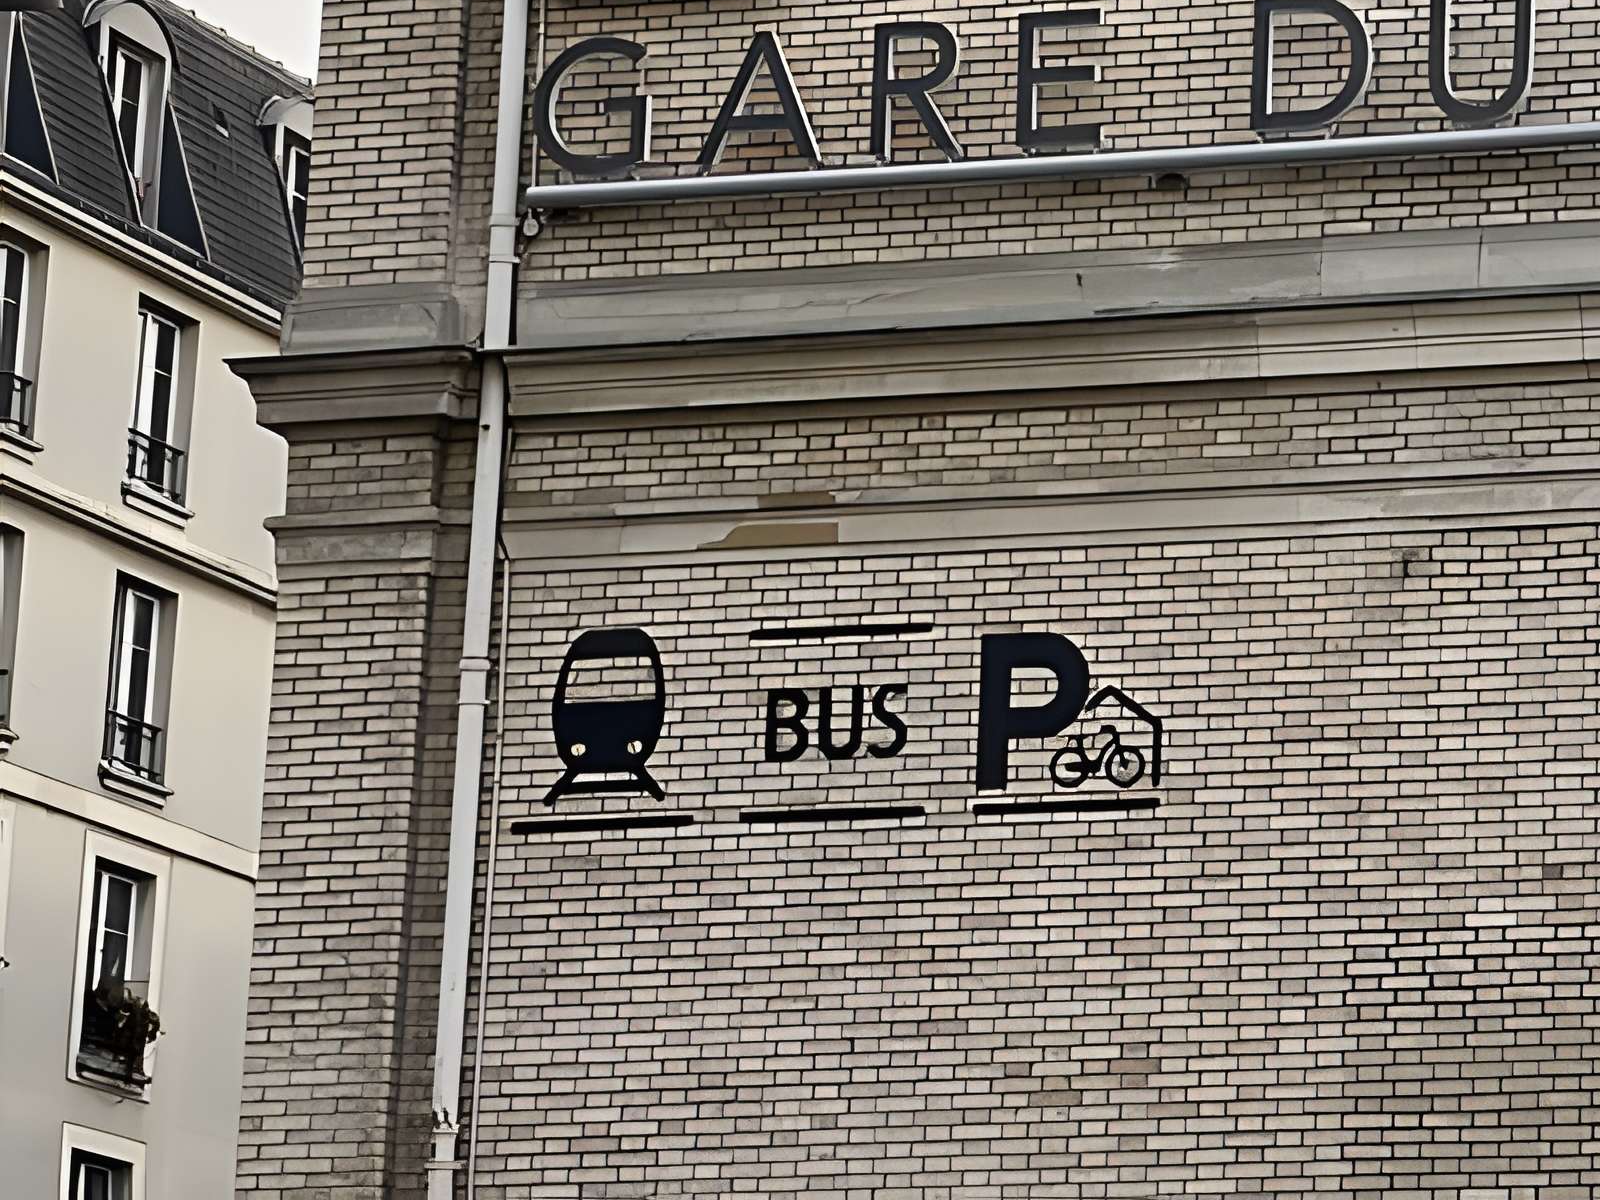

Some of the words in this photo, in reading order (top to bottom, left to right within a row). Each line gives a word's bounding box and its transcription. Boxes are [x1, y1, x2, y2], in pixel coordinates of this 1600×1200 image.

[533, 7, 1105, 176] GARE
[764, 683, 908, 764] BUS
[975, 631, 1091, 792] P
